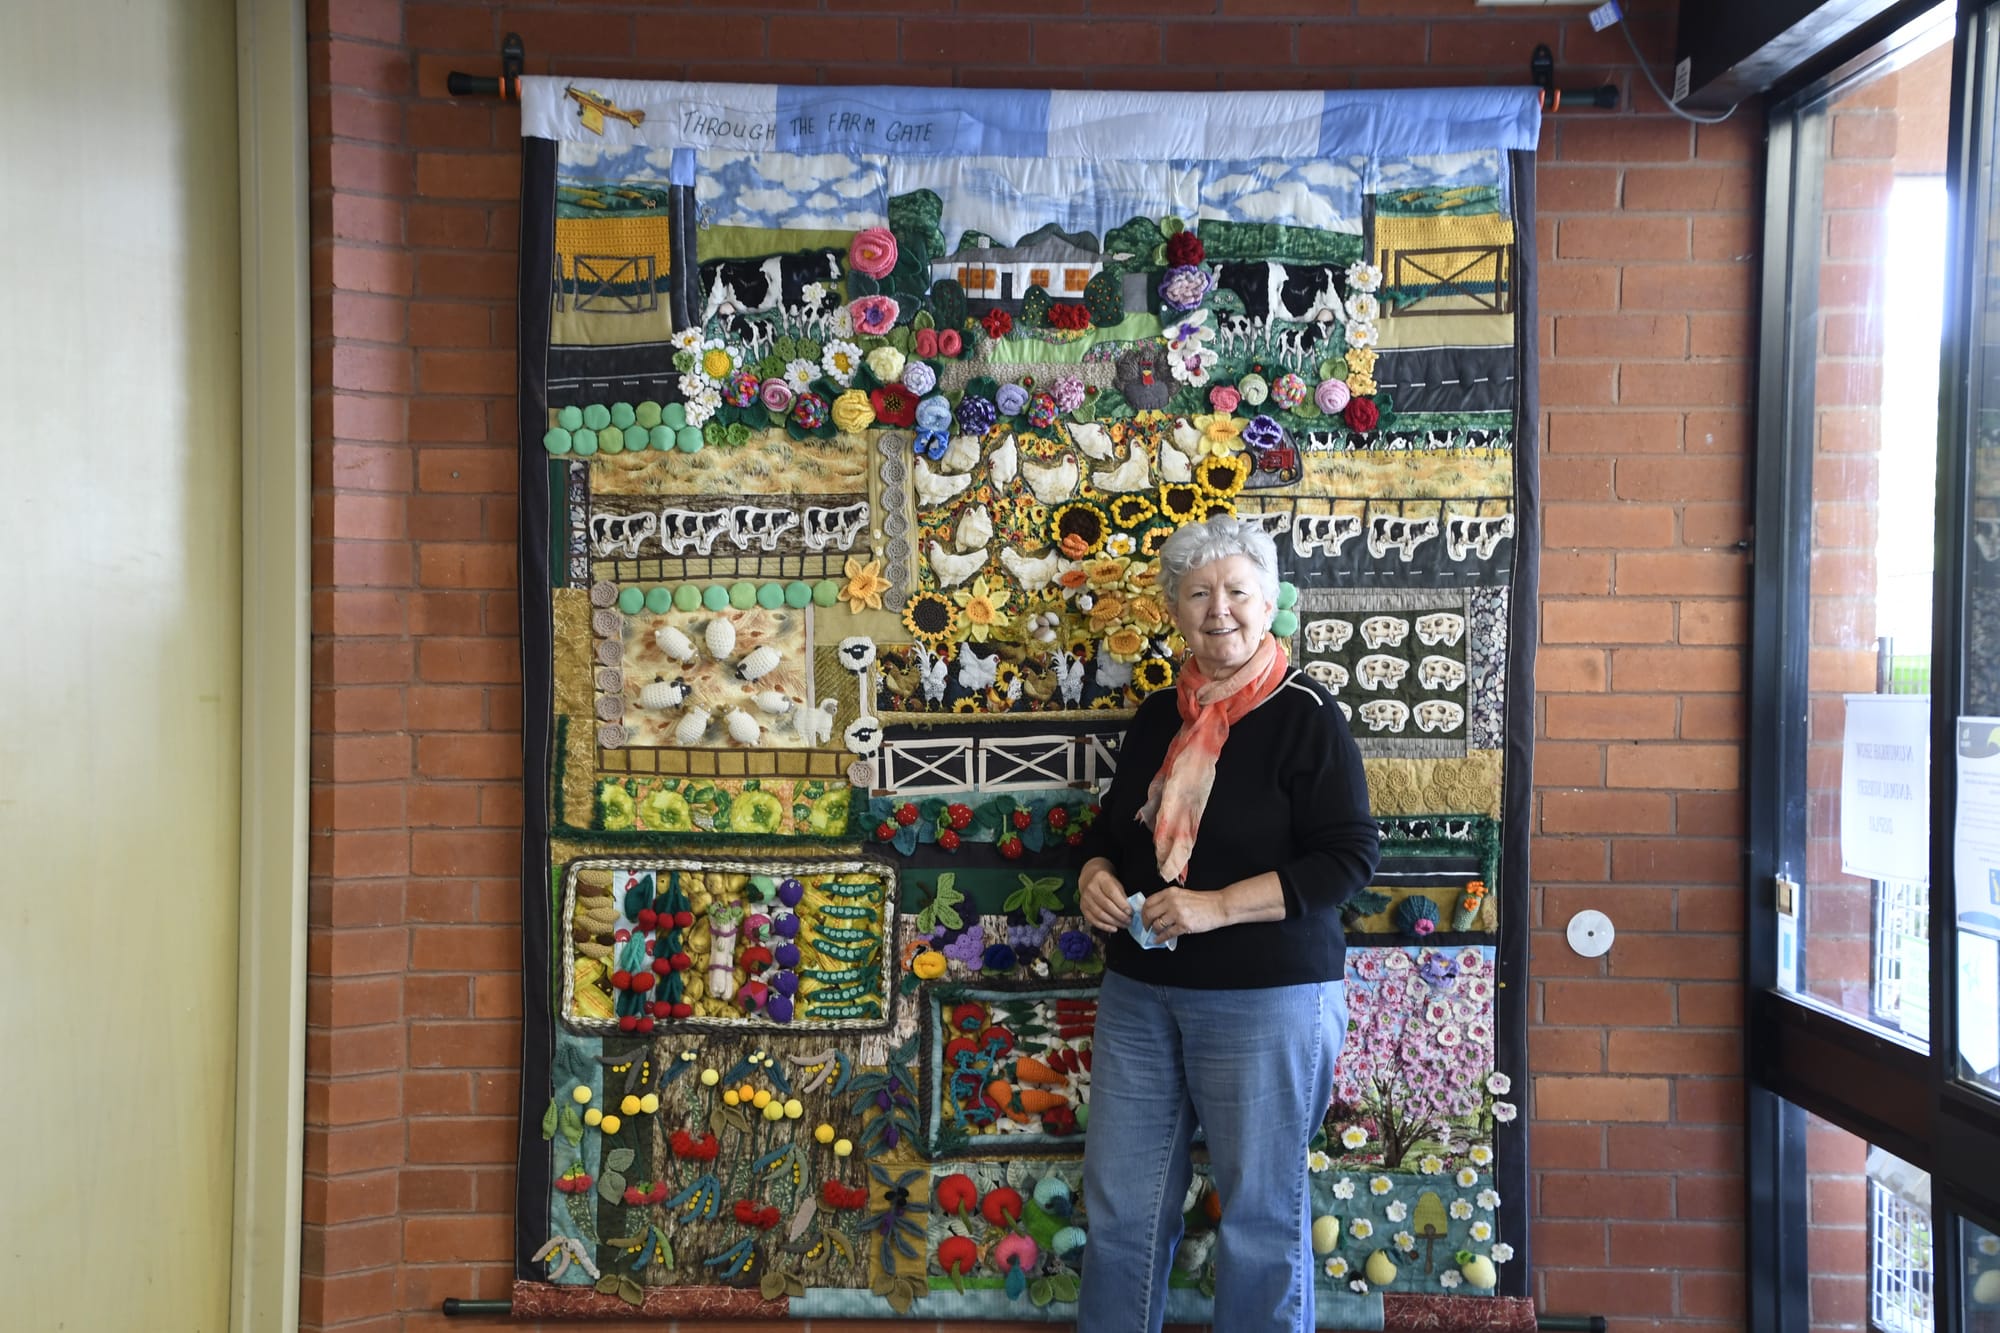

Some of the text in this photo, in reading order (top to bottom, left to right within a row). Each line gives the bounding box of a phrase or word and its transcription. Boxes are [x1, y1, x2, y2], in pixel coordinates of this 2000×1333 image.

[683, 110, 933, 142] THROUGH THE FARM GATE
